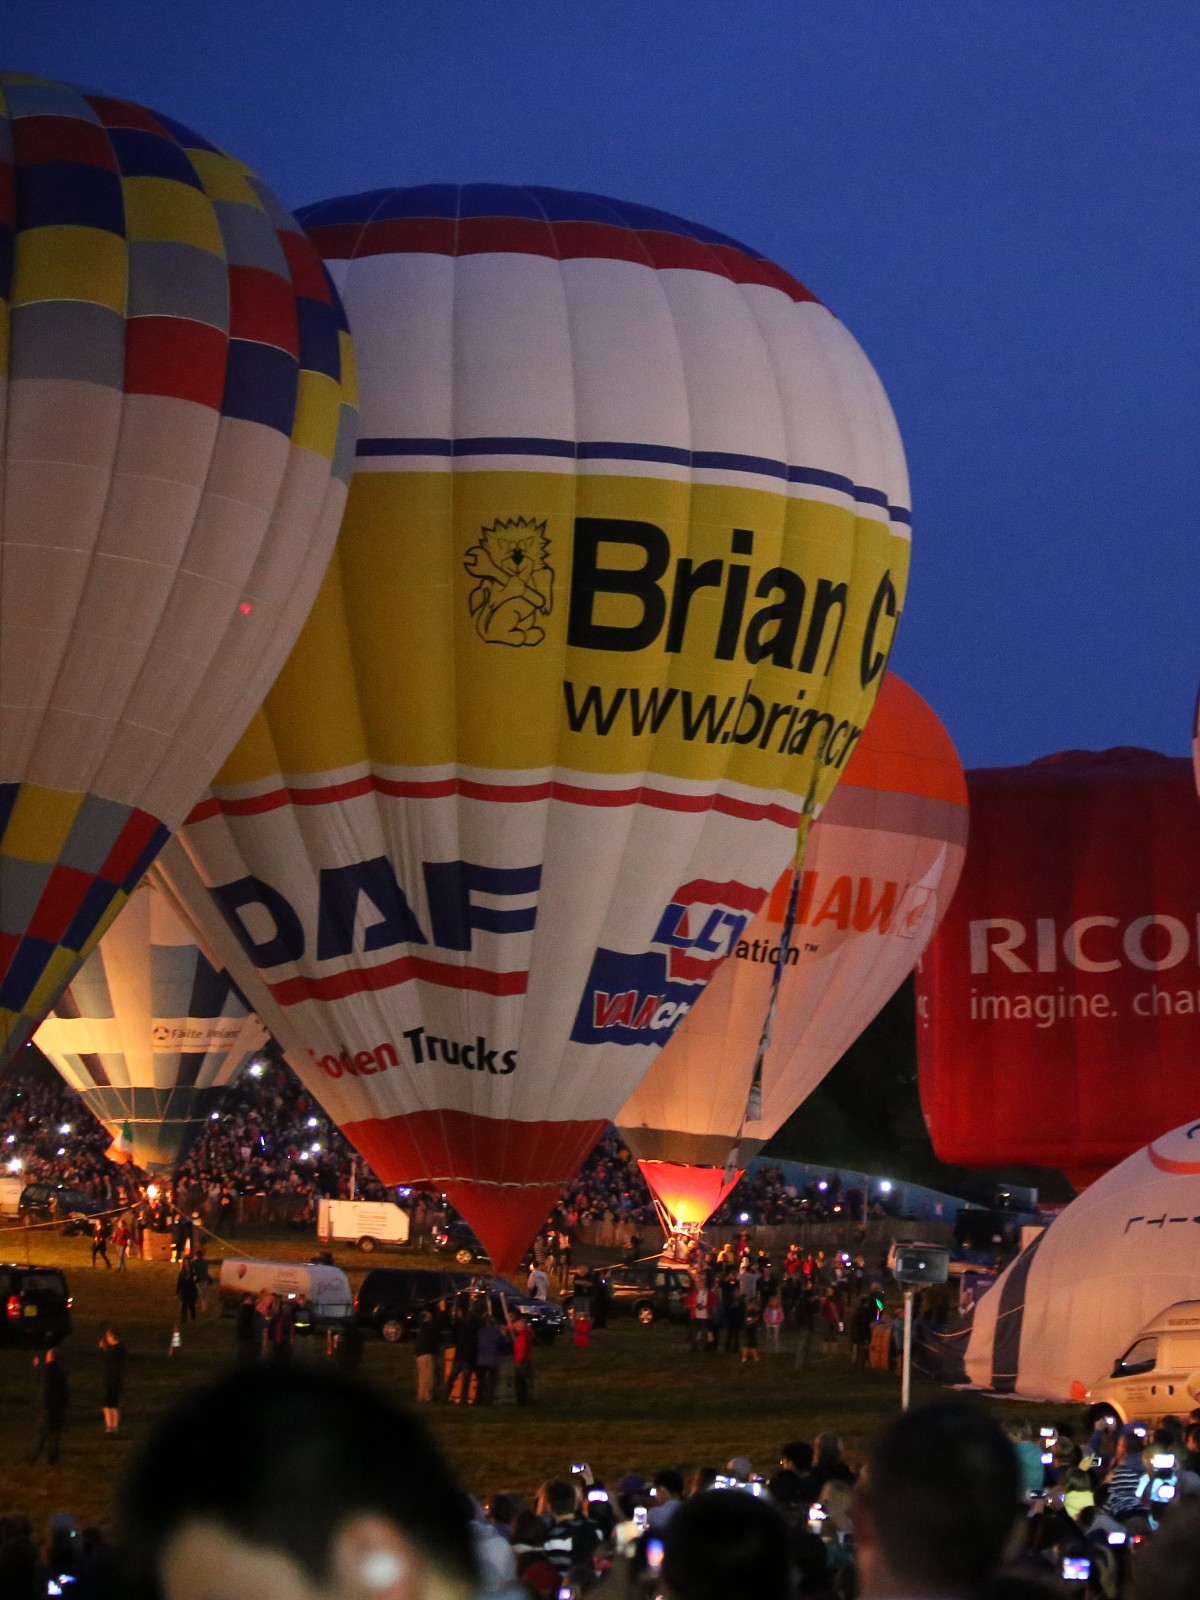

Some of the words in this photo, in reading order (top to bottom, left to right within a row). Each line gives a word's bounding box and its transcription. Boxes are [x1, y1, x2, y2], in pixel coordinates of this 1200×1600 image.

[566, 517, 848, 676] Brian
[861, 569, 900, 690] C
[208, 856, 542, 969] DAF
[970, 988, 1118, 1029] imagine.
[403, 1026, 518, 1075] Trucks
